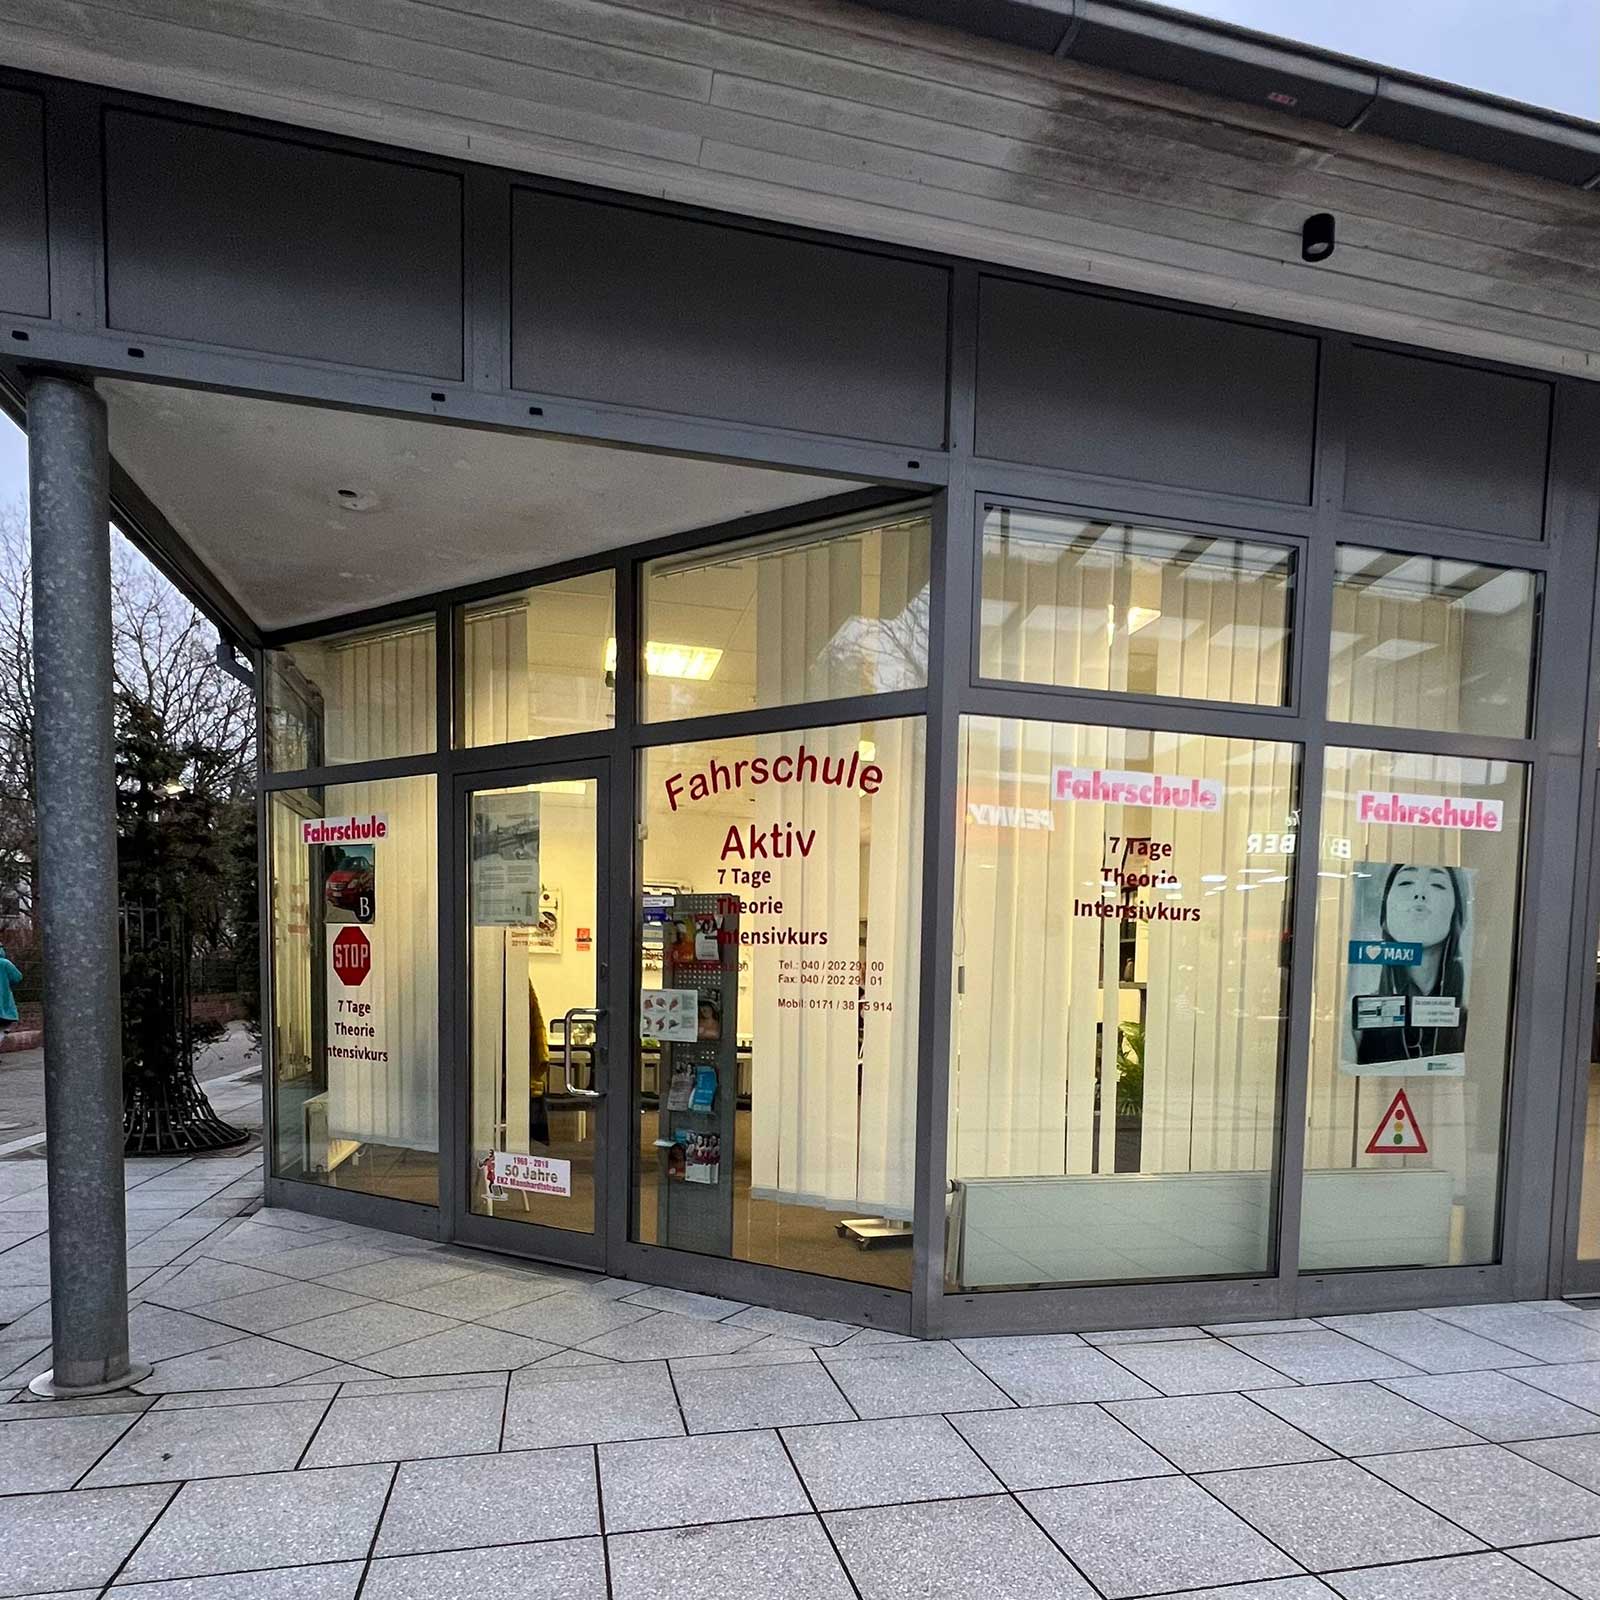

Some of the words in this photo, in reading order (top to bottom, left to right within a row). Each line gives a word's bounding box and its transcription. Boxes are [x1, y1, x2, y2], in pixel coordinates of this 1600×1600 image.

[664, 745, 884, 812] Fahrschule
[1056, 769, 1217, 809] Fahrschule
[1361, 794, 1499, 830] Fahrschule
[303, 815, 387, 843] Fahrschule
[720, 822, 817, 861] Aktiv
[1109, 836, 1120, 854] 7
[1126, 836, 1173, 861] Tage
[717, 868, 727, 885] 7
[731, 868, 772, 889] Tage
[1100, 867, 1178, 889] Theorie
[359, 896, 371, 918] B
[717, 895, 784, 915] Theorie
[1073, 898, 1202, 922] Intensivkurs
[334, 943, 369, 969] STOP
[1358, 946, 1363, 960] I
[1383, 946, 1415, 961] MAX!
[801, 960, 820, 971] 040
[828, 961, 847, 972] 202
[871, 961, 885, 972] 00
[800, 974, 819, 984] 040
[827, 975, 846, 985] 202
[870, 976, 883, 986] 01
[337, 1000, 344, 1013] 7
[346, 1000, 371, 1017] Tage
[777, 998, 807, 1009] Mobil:
[809, 999, 833, 1010] 0171
[842, 1000, 855, 1011] 38
[873, 1001, 893, 1012] 914
[334, 1022, 376, 1038] Theorie
[326, 1045, 389, 1063] ntensivkurs
[504, 1165, 519, 1178] 50
[522, 1167, 558, 1183] Jahre
